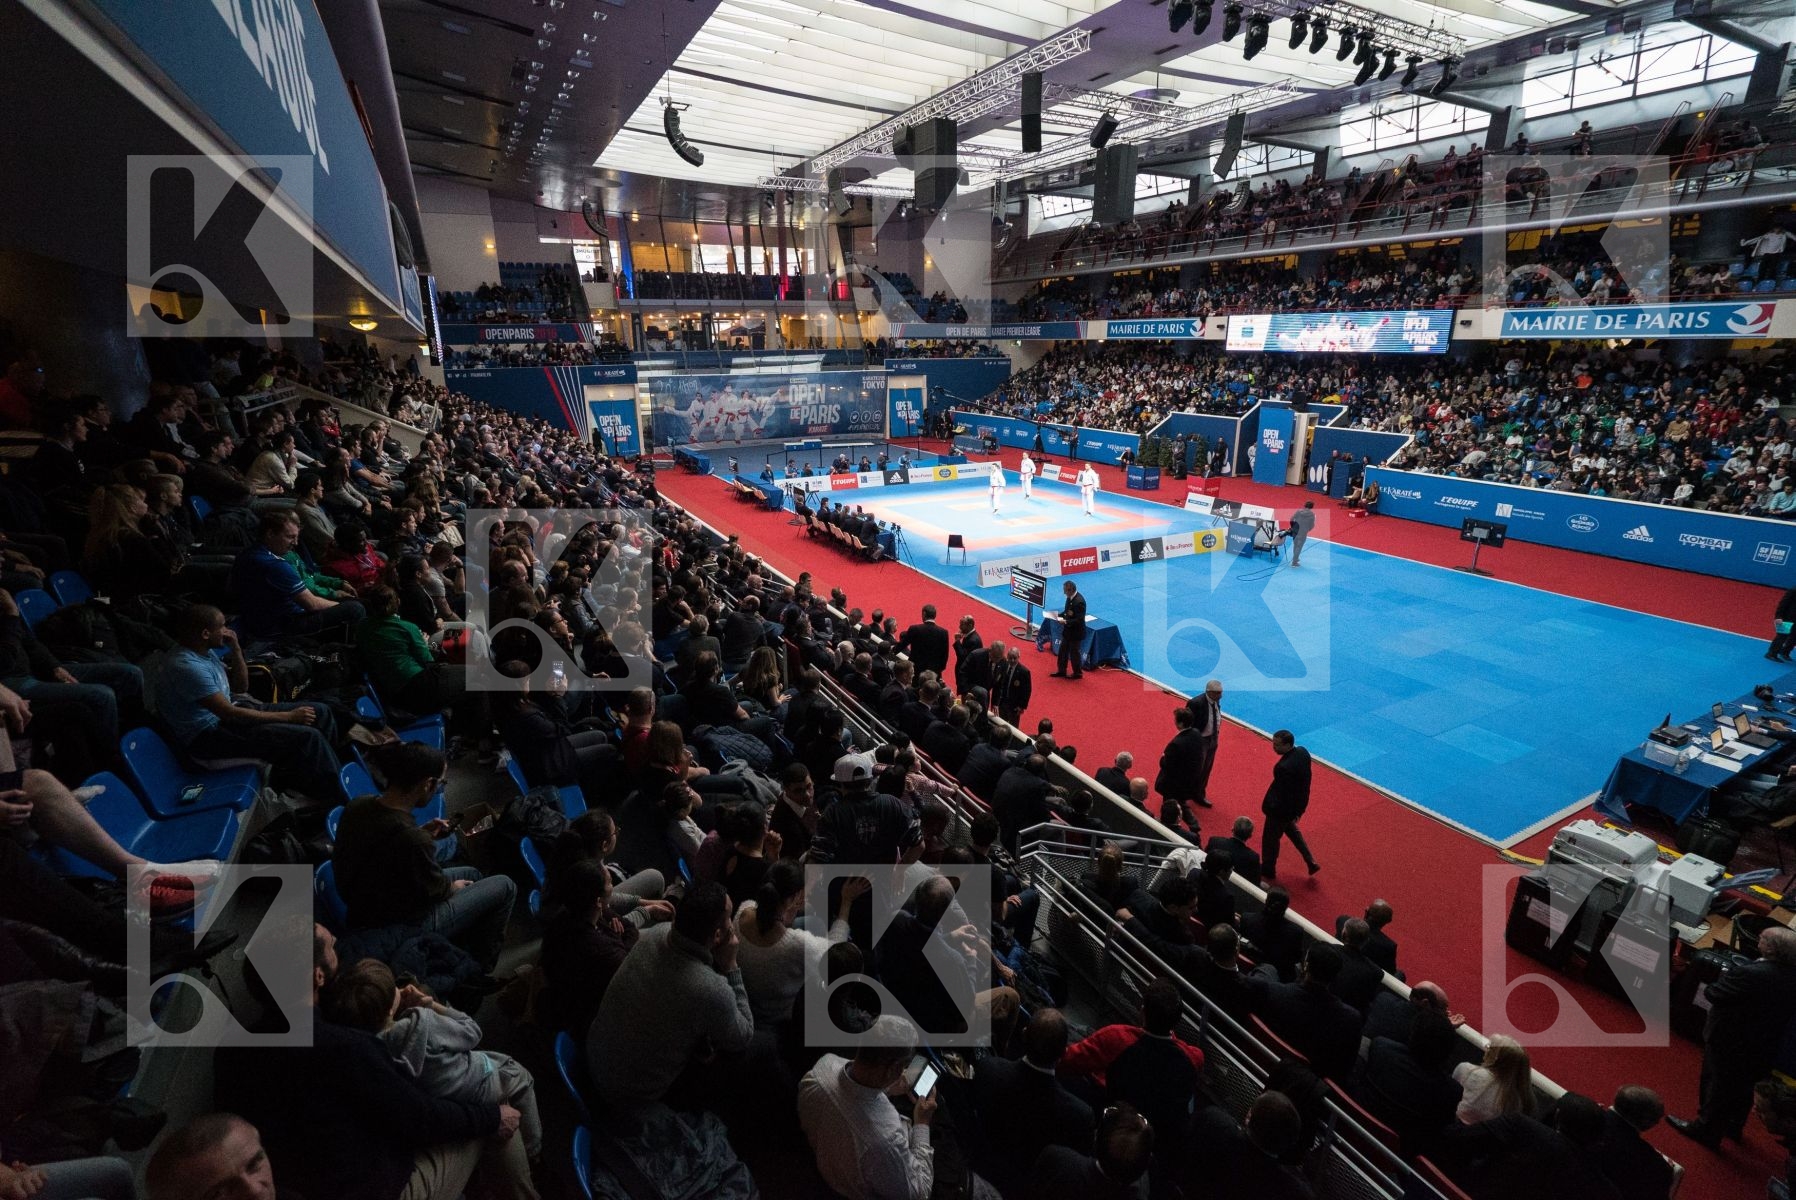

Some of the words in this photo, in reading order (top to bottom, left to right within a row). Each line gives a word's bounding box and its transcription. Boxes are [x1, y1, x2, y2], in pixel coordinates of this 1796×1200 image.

[1509, 315, 1588, 331] MAIRIE
[1595, 314, 1628, 329] DE
[1635, 311, 1711, 329] PARIS
[945, 327, 961, 337] OPEN
[961, 327, 970, 337] DE
[970, 327, 987, 337] PARIS
[1110, 324, 1141, 334] MAIRIE
[1143, 324, 1156, 334] DE
[1157, 323, 1185, 334] PARIS
[862, 380, 885, 390] TOKYO
[788, 383, 826, 406] OPEN
[599, 414, 622, 427] OPEN
[800, 404, 840, 426] PARIS
[607, 424, 633, 438] PARIS
[1262, 428, 1280, 440] OPEN
[1440, 496, 1479, 507] L'EQUIPE
[1622, 532, 1654, 543] adidas
[1680, 534, 1731, 548] KOMBAT
[1138, 550, 1157, 560] adidas
[1063, 555, 1095, 568] L'EQUIPE
